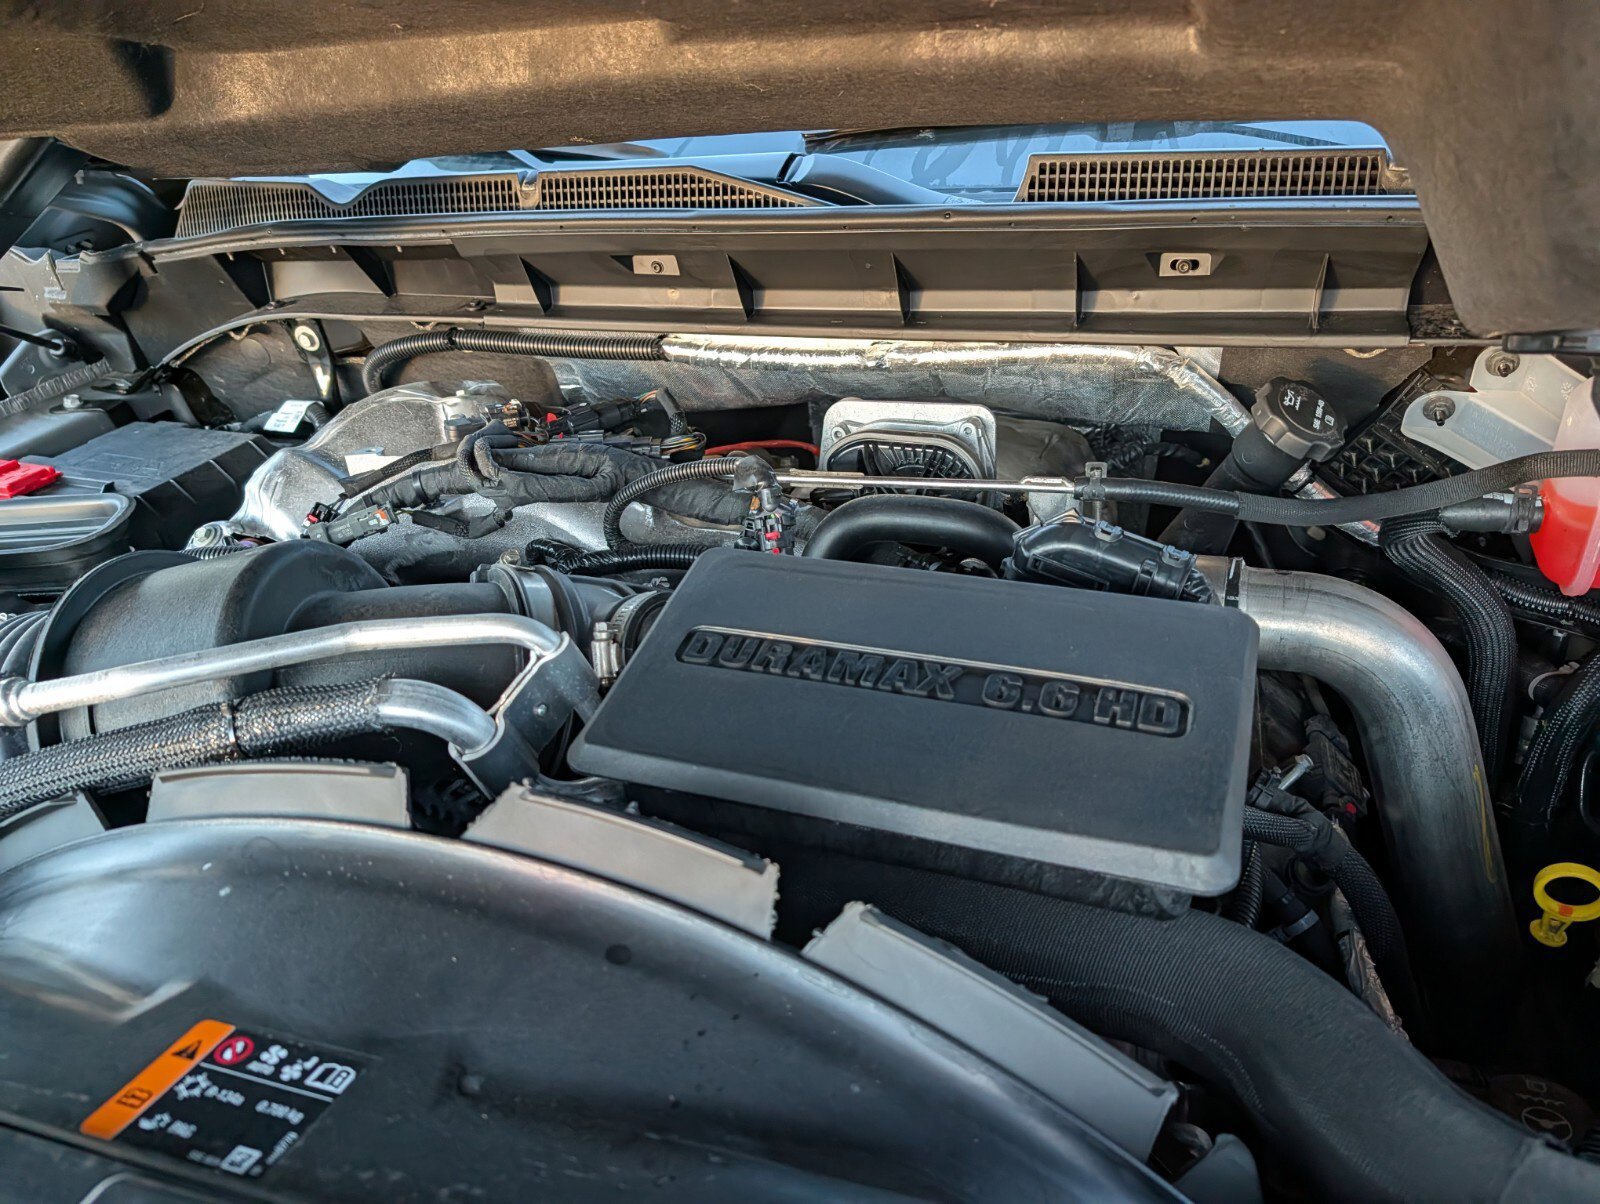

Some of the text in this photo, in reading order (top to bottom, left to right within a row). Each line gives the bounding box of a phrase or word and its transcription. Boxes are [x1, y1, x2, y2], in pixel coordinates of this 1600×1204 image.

[681, 631, 1182, 735] DURAMAX 6.6 HD
